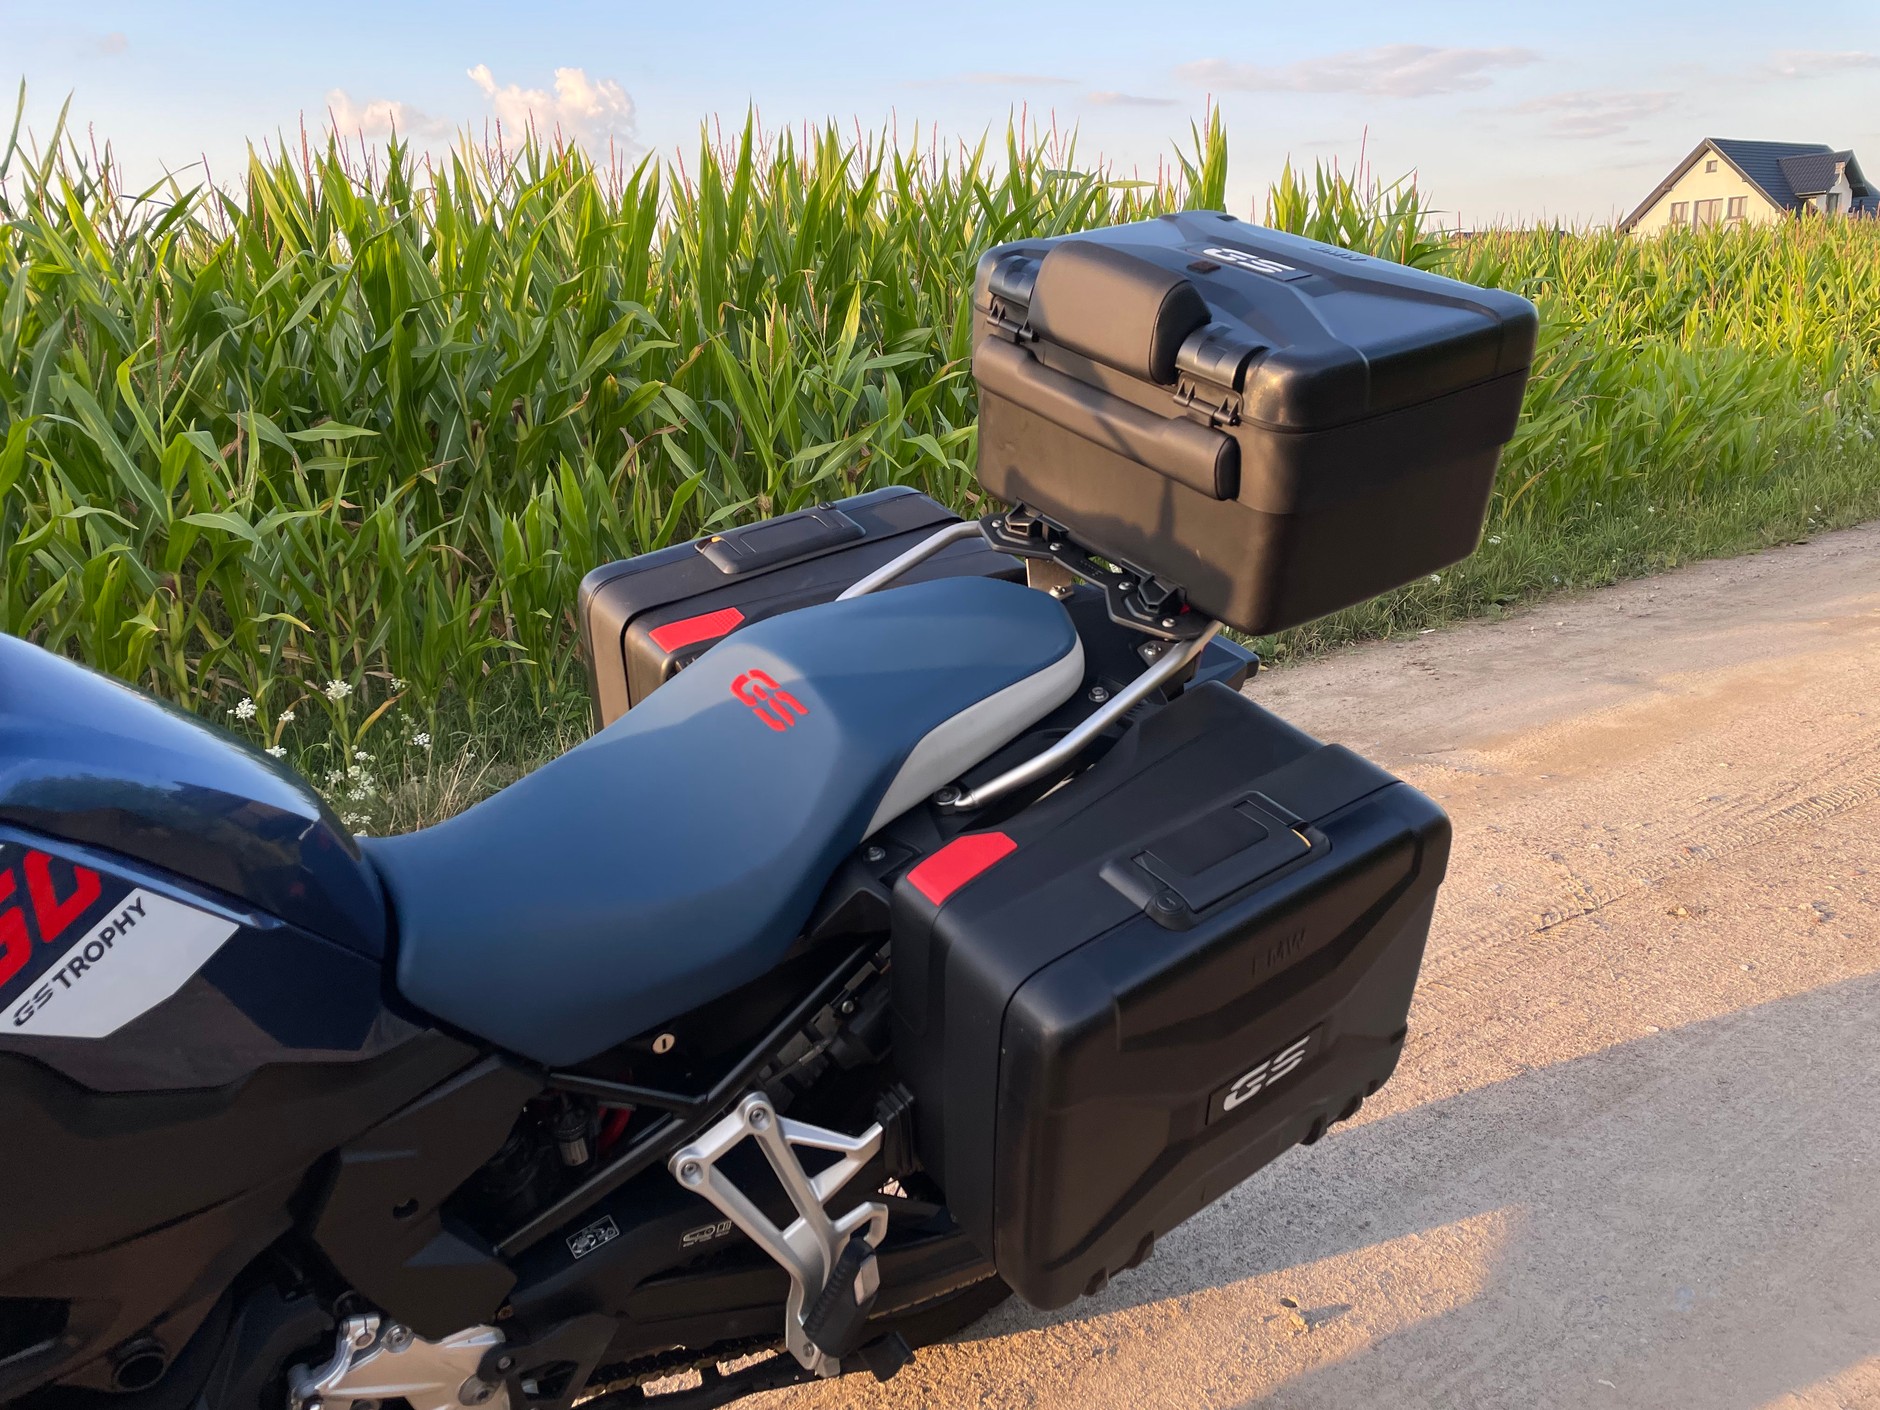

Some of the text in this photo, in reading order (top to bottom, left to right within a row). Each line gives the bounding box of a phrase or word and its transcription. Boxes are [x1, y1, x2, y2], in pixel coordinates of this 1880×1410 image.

[1203, 248, 1296, 273] GS
[730, 668, 809, 732] GS
[12, 896, 147, 1027] GS TROPHY
[1223, 1035, 1310, 1111] GS
